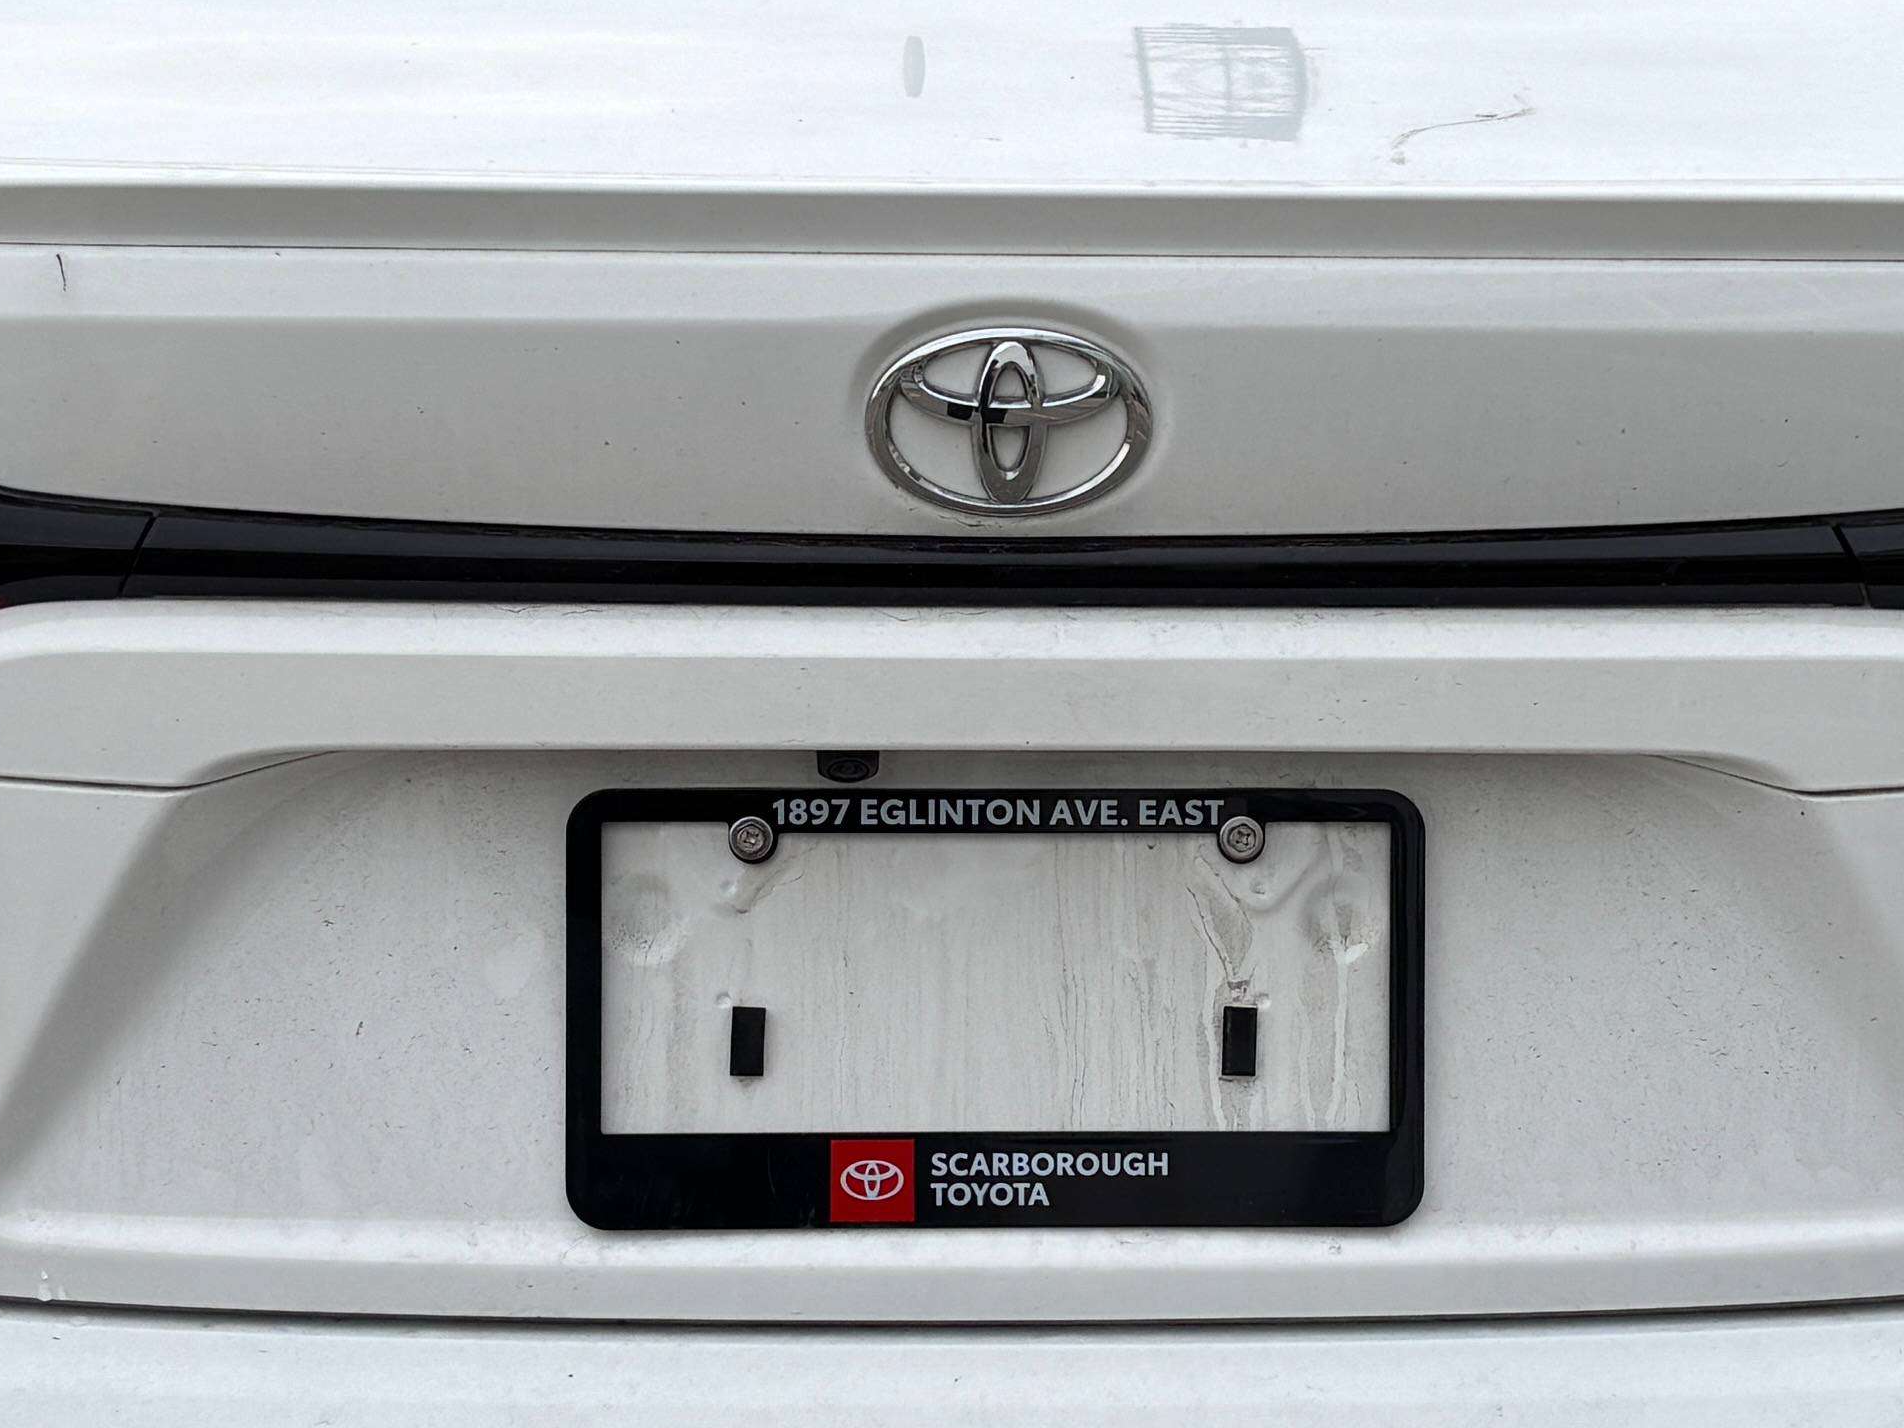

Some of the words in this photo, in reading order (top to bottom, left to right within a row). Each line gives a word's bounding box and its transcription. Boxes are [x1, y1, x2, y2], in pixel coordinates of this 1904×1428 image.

[772, 798, 849, 826] 1897
[859, 798, 1039, 826] EGLINTON
[1049, 798, 1129, 826] AVE.
[1138, 798, 1225, 826] EAST
[930, 1151, 1170, 1177] SCARBOROUGH
[929, 1182, 1050, 1207] TOYOTA
